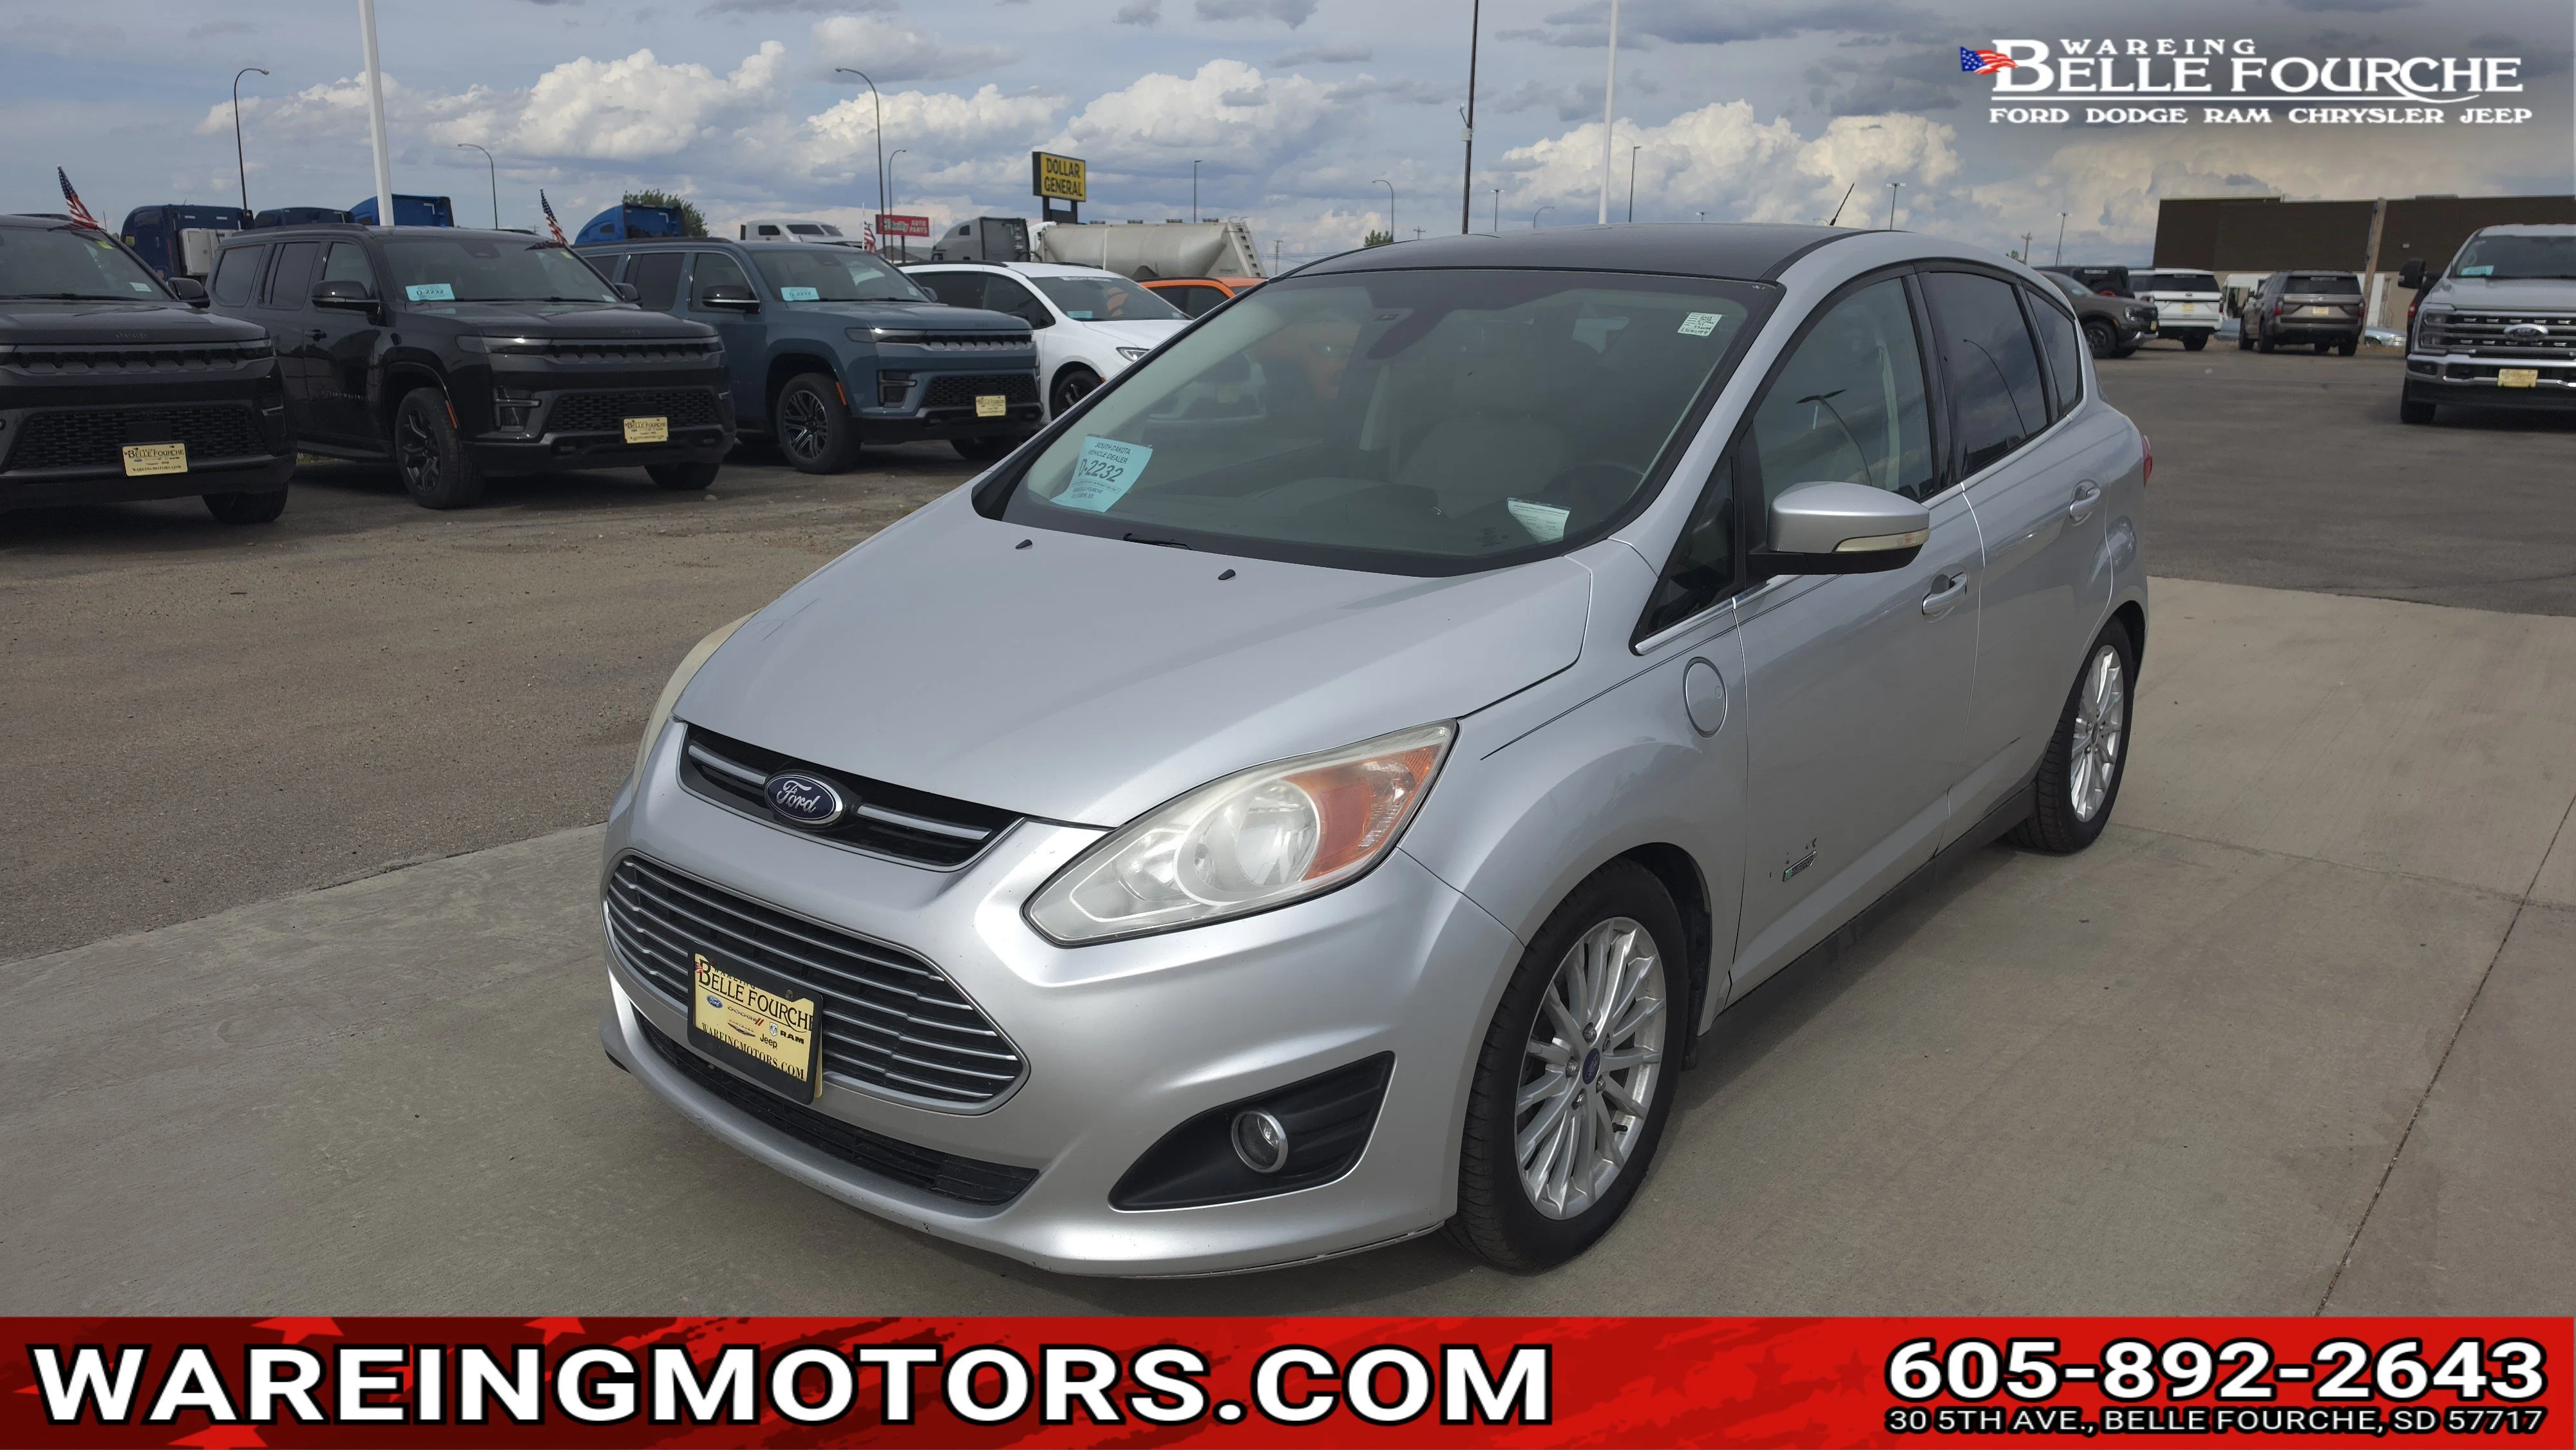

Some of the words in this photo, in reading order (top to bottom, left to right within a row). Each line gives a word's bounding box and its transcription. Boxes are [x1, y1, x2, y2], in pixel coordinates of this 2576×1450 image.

[1046, 158, 1081, 179] DOLLAR
[1044, 176, 1083, 196] GENERAL
[1088, 449, 1108, 458] VEHICLE
[1106, 453, 1128, 464] DEALER
[1094, 442, 1112, 450] SOUTH
[1111, 444, 1131, 455] DAKOTA
[1078, 458, 1124, 482] D-2232
[776, 780, 821, 813] Ford
[699, 959, 744, 1003] BELLE
[760, 1033, 778, 1049] Jeep
[780, 1030, 804, 1044] RAM
[702, 1022, 804, 1080] WAREINGMOTORS.COM
